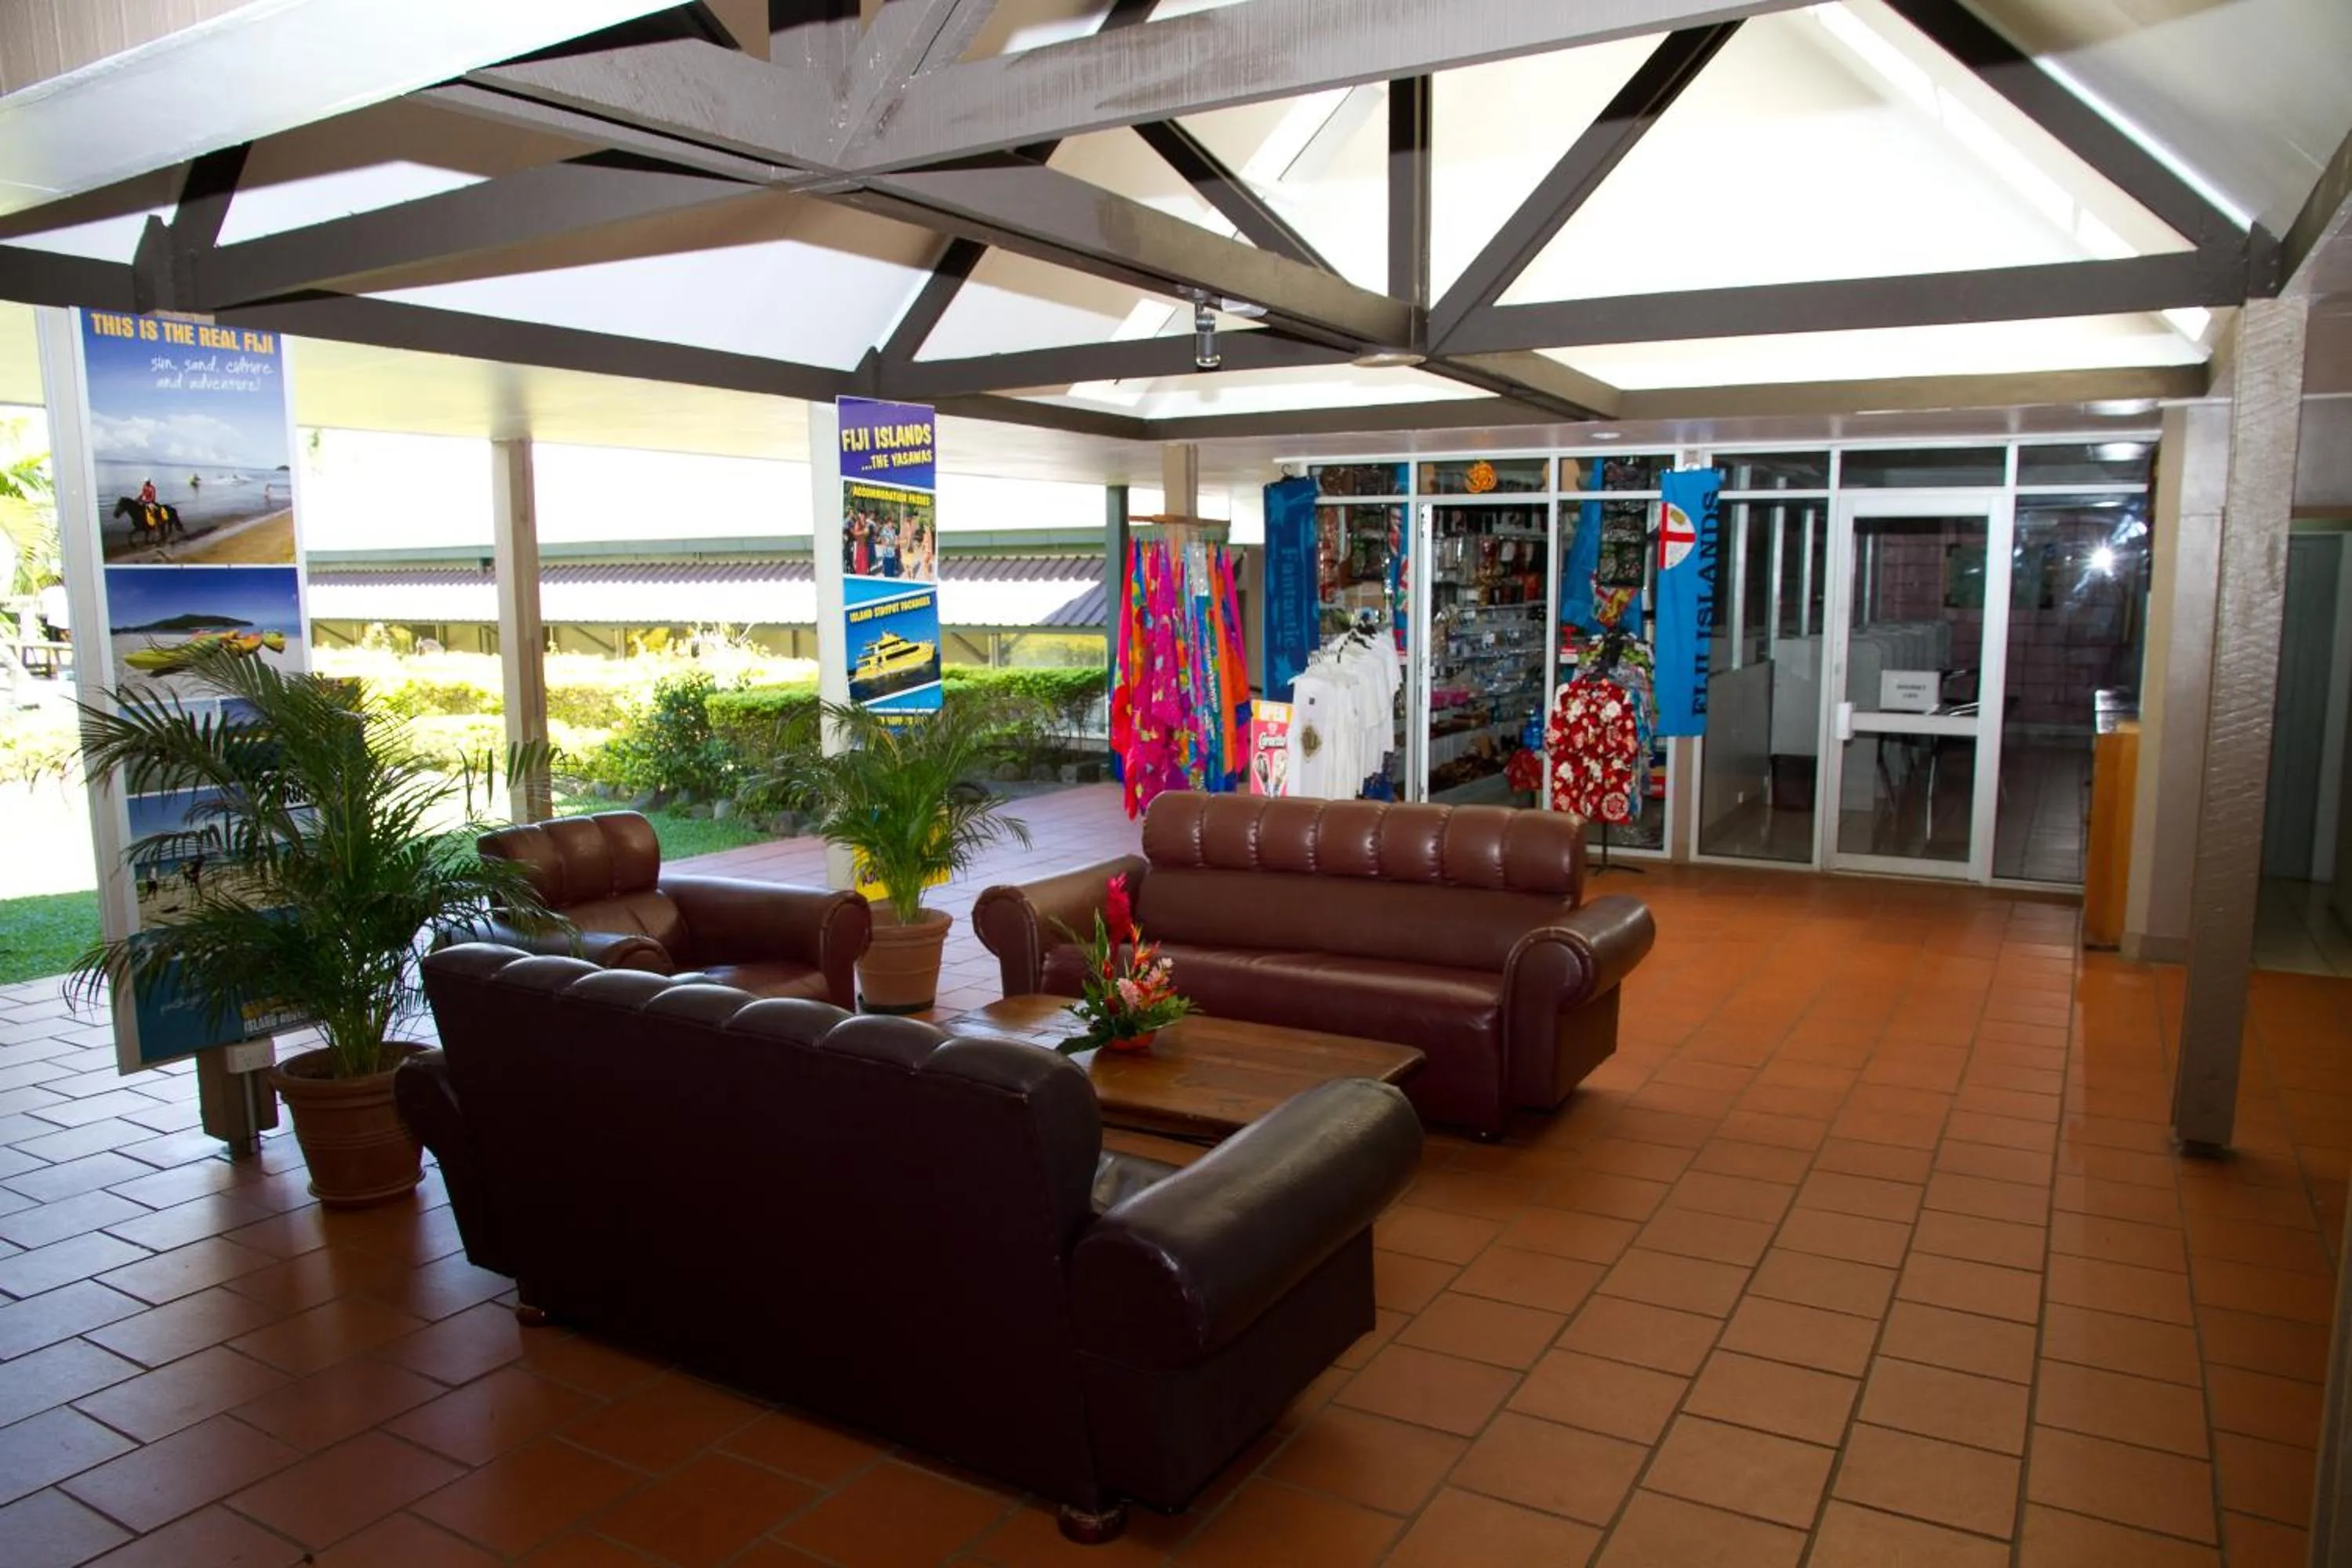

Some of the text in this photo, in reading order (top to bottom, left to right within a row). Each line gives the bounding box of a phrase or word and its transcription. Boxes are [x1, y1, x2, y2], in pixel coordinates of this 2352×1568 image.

[90, 313, 275, 354] THIS IS THE REAL FIJI
[156, 372, 182, 389] and
[841, 423, 932, 452] FIJI ISLANDS
[1281, 546, 1300, 650] Fantastic
[1693, 489, 1720, 718] FIJI ISLANDS
